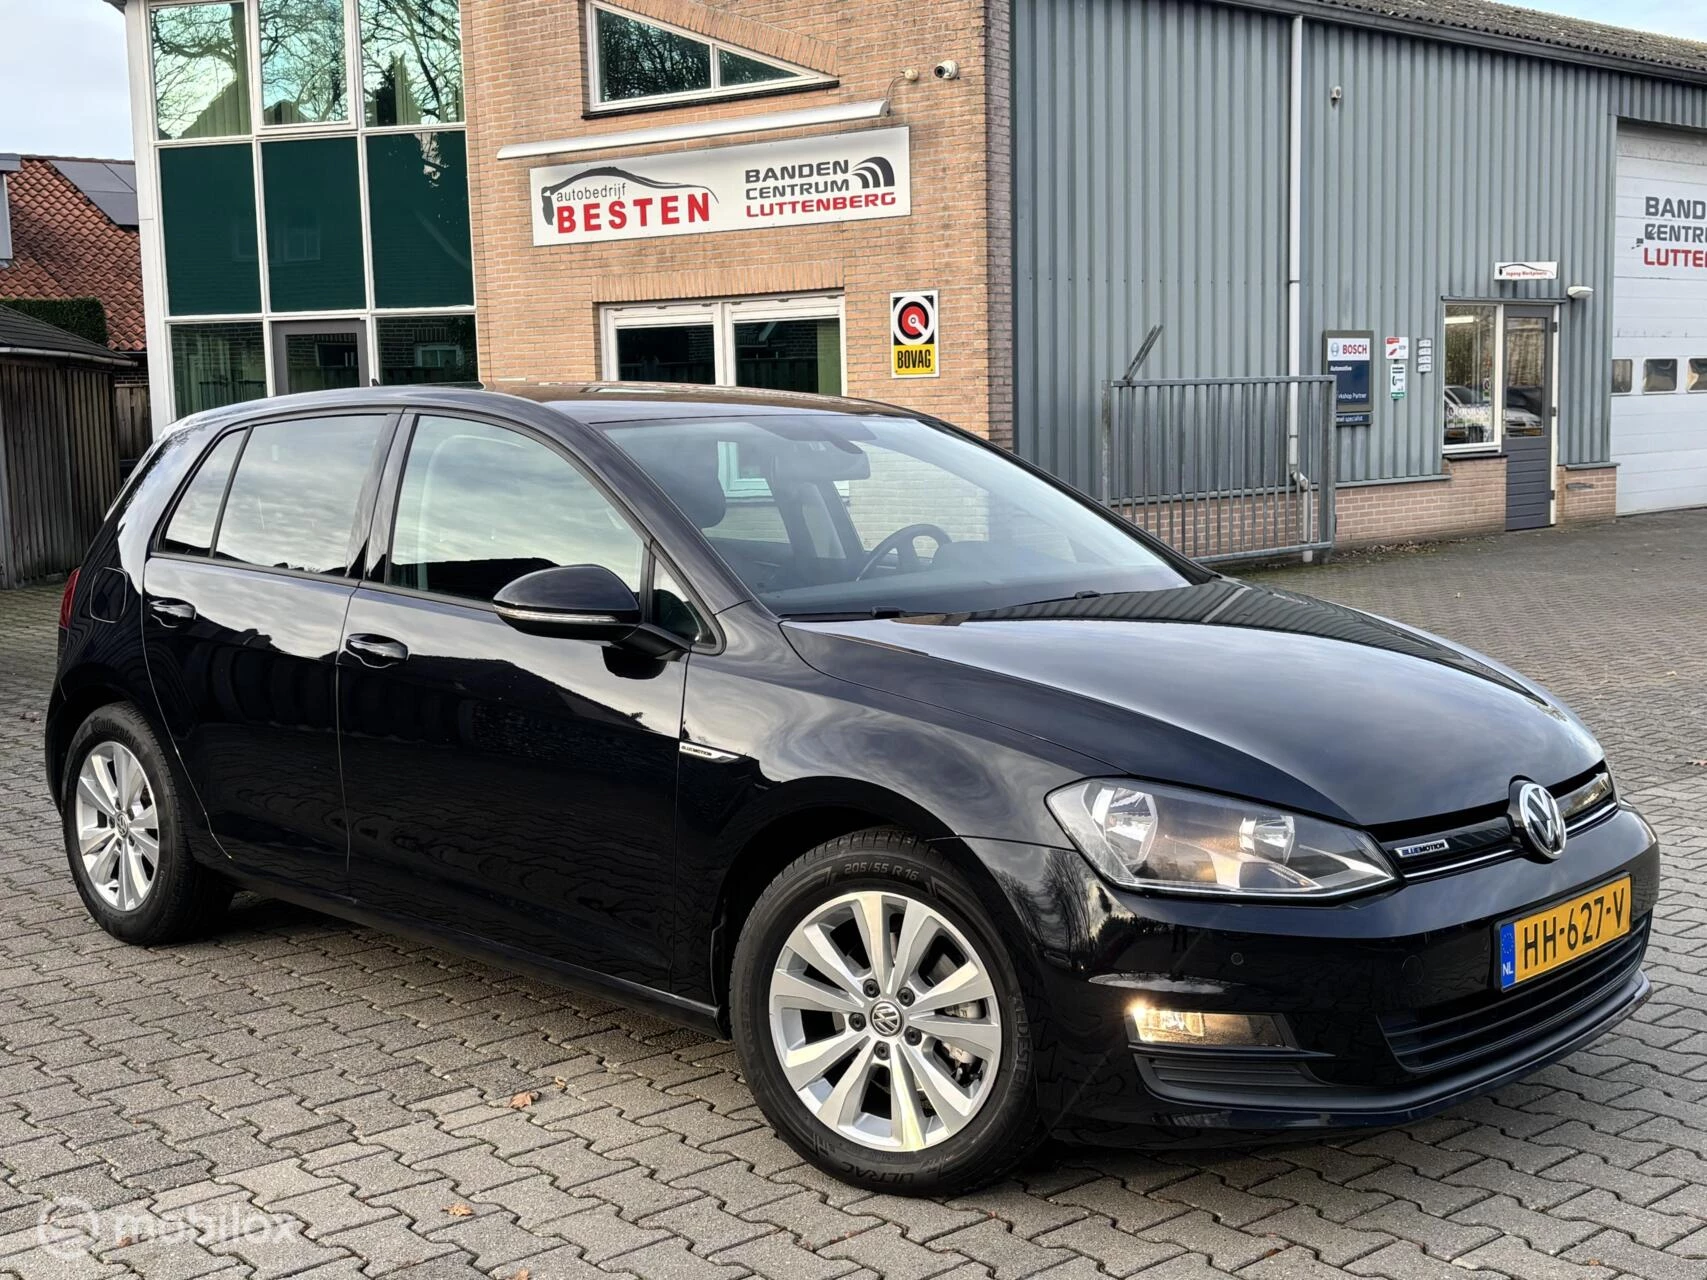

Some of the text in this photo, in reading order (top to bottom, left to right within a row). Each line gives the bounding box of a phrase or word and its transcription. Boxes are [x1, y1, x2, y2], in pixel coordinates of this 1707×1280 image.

[745, 159, 849, 184] BANDEN
[556, 182, 627, 203] autobedrijf
[745, 178, 850, 201] CENTRUM
[556, 192, 710, 234] BESTEN
[746, 191, 896, 218] LUTTENBERG
[1645, 196, 1706, 220] BAND
[1644, 223, 1707, 244] CENTR
[1643, 247, 1707, 268] LUTTE
[897, 349, 931, 369] BOVAG
[1342, 344, 1368, 355] BOSCH
[1402, 842, 1446, 856] BLUEMOTION
[844, 862, 889, 874] 205/55
[1524, 887, 1625, 970] HH-627-V
[1503, 963, 1514, 976] NL
